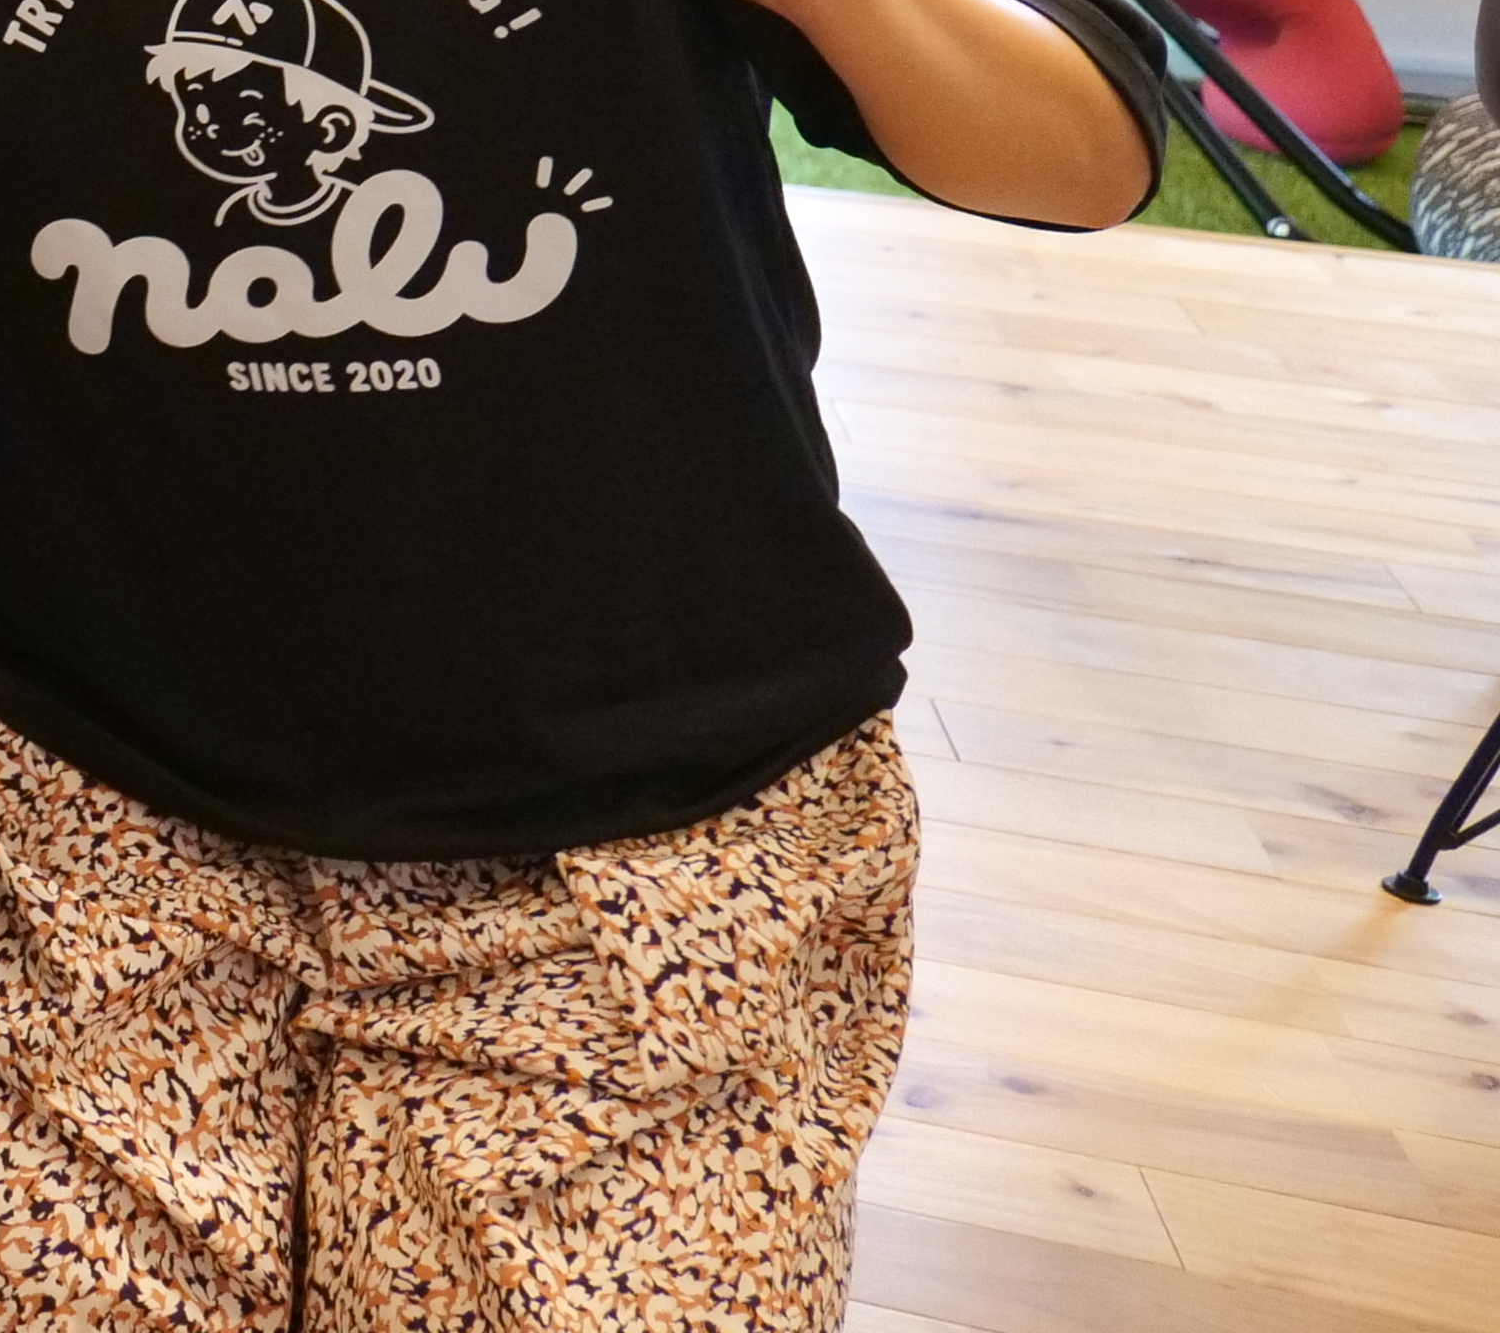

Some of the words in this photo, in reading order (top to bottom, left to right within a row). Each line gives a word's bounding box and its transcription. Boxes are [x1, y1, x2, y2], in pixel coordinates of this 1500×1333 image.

[30, 169, 578, 355] nalu
[226, 360, 336, 393] SINCE
[346, 357, 442, 393] 2020
